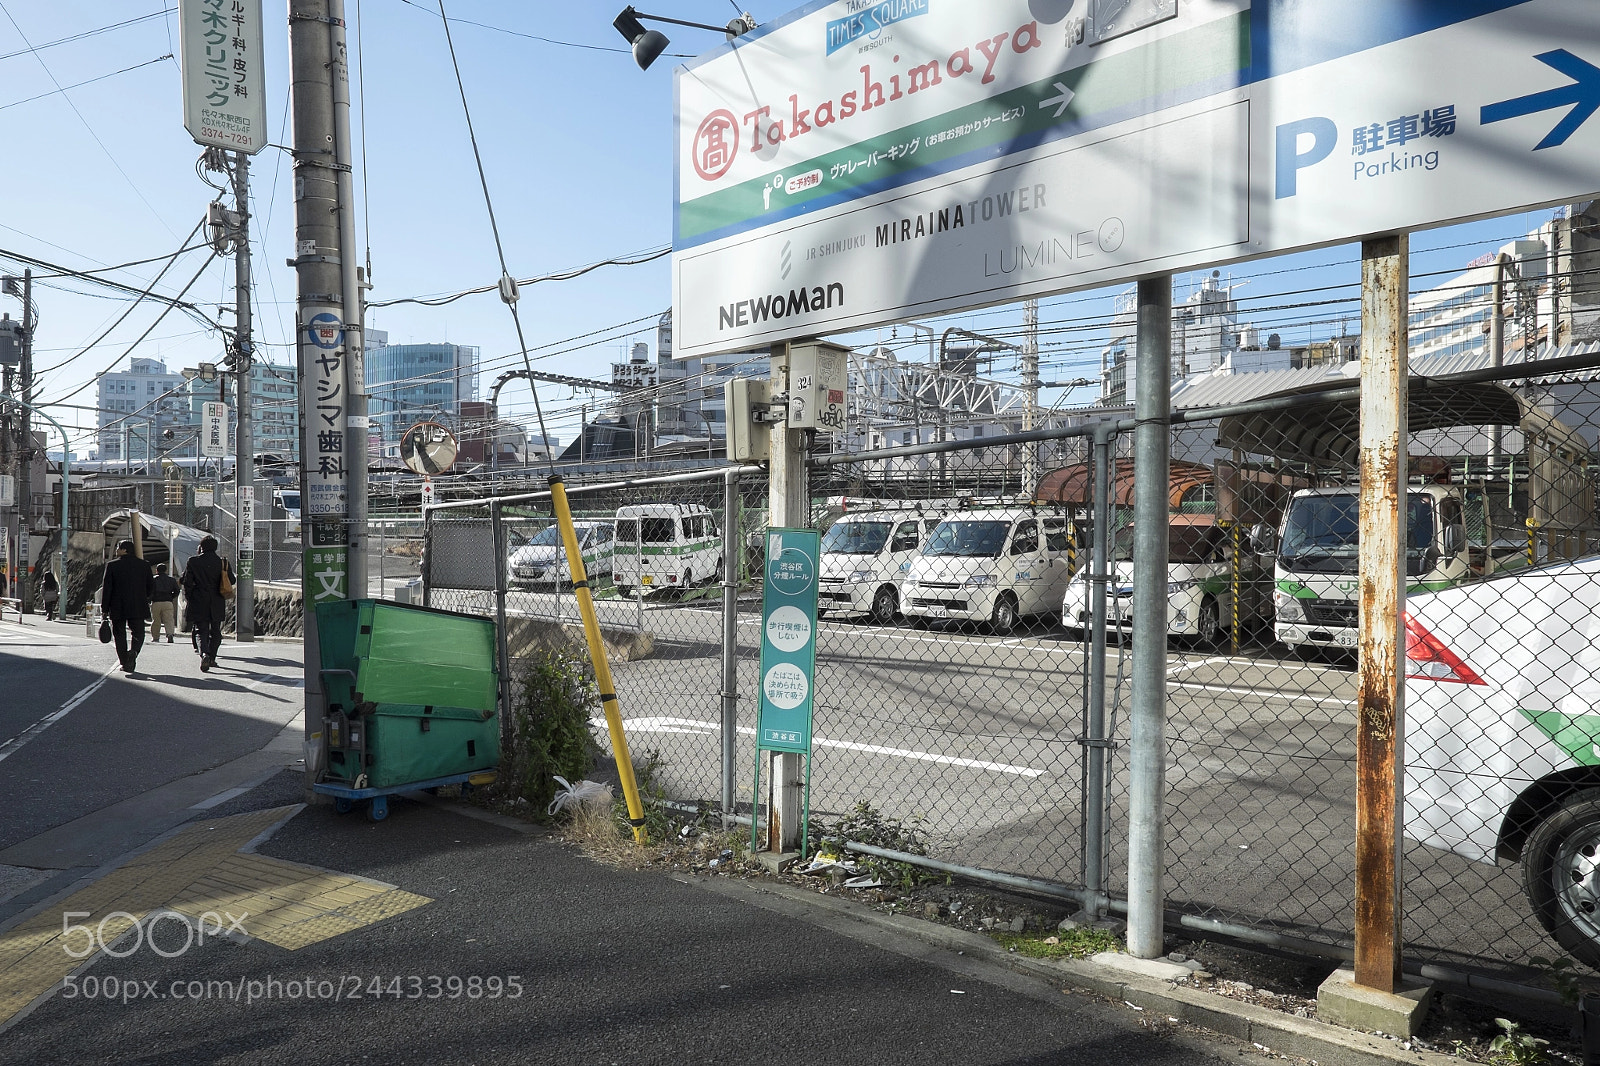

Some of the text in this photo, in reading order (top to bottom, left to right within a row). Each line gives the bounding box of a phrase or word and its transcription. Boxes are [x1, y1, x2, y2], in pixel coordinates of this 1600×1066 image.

[829, 13, 865, 47] TIMES
[743, 20, 1042, 153] Takashimaya
[201, 108, 251, 126] 代々木駅西口
[201, 126, 252, 146] 3374-7291
[1351, 104, 1457, 156] 駐車場
[1275, 116, 1338, 200] P
[1353, 150, 1440, 181] Parking
[789, 172, 819, 191] ご予約制
[805, 247, 816, 261] JR
[819, 234, 866, 257] SHINJUKU
[315, 353, 344, 480] ヤシマ歯科
[210, 417, 220, 445] 中央医院
[773, 571, 809, 581] 分煙ルール
[780, 562, 803, 572] 渋谷区
[314, 566, 346, 600] 文
[769, 621, 808, 632] 歩行喫煙は
[778, 631, 799, 640] しない
[772, 670, 800, 681] たばこは
[767, 689, 804, 700] 場所で吸う
[768, 680, 804, 691] 決められた
[771, 731, 796, 741] 渋谷区
